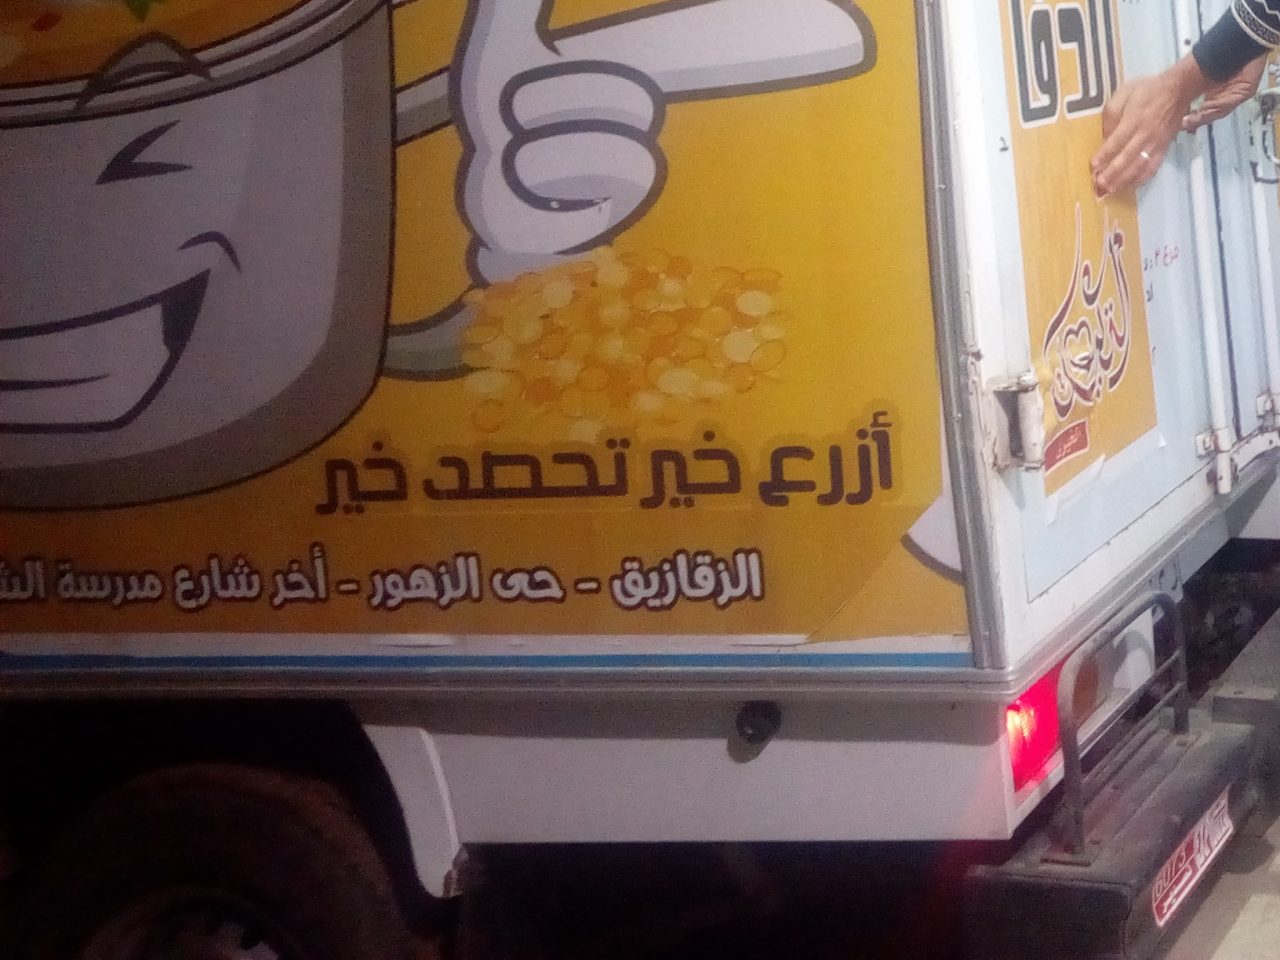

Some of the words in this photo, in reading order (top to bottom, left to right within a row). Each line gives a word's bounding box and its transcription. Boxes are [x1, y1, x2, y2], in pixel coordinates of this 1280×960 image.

[314, 441, 408, 514] خير
[423, 438, 630, 500] تحصد
[640, 430, 742, 510] خير
[56, 560, 164, 608] مدرسة
[172, 551, 262, 612] شارع
[368, 552, 481, 611] الزهور
[611, 548, 764, 612] الزقازيق
